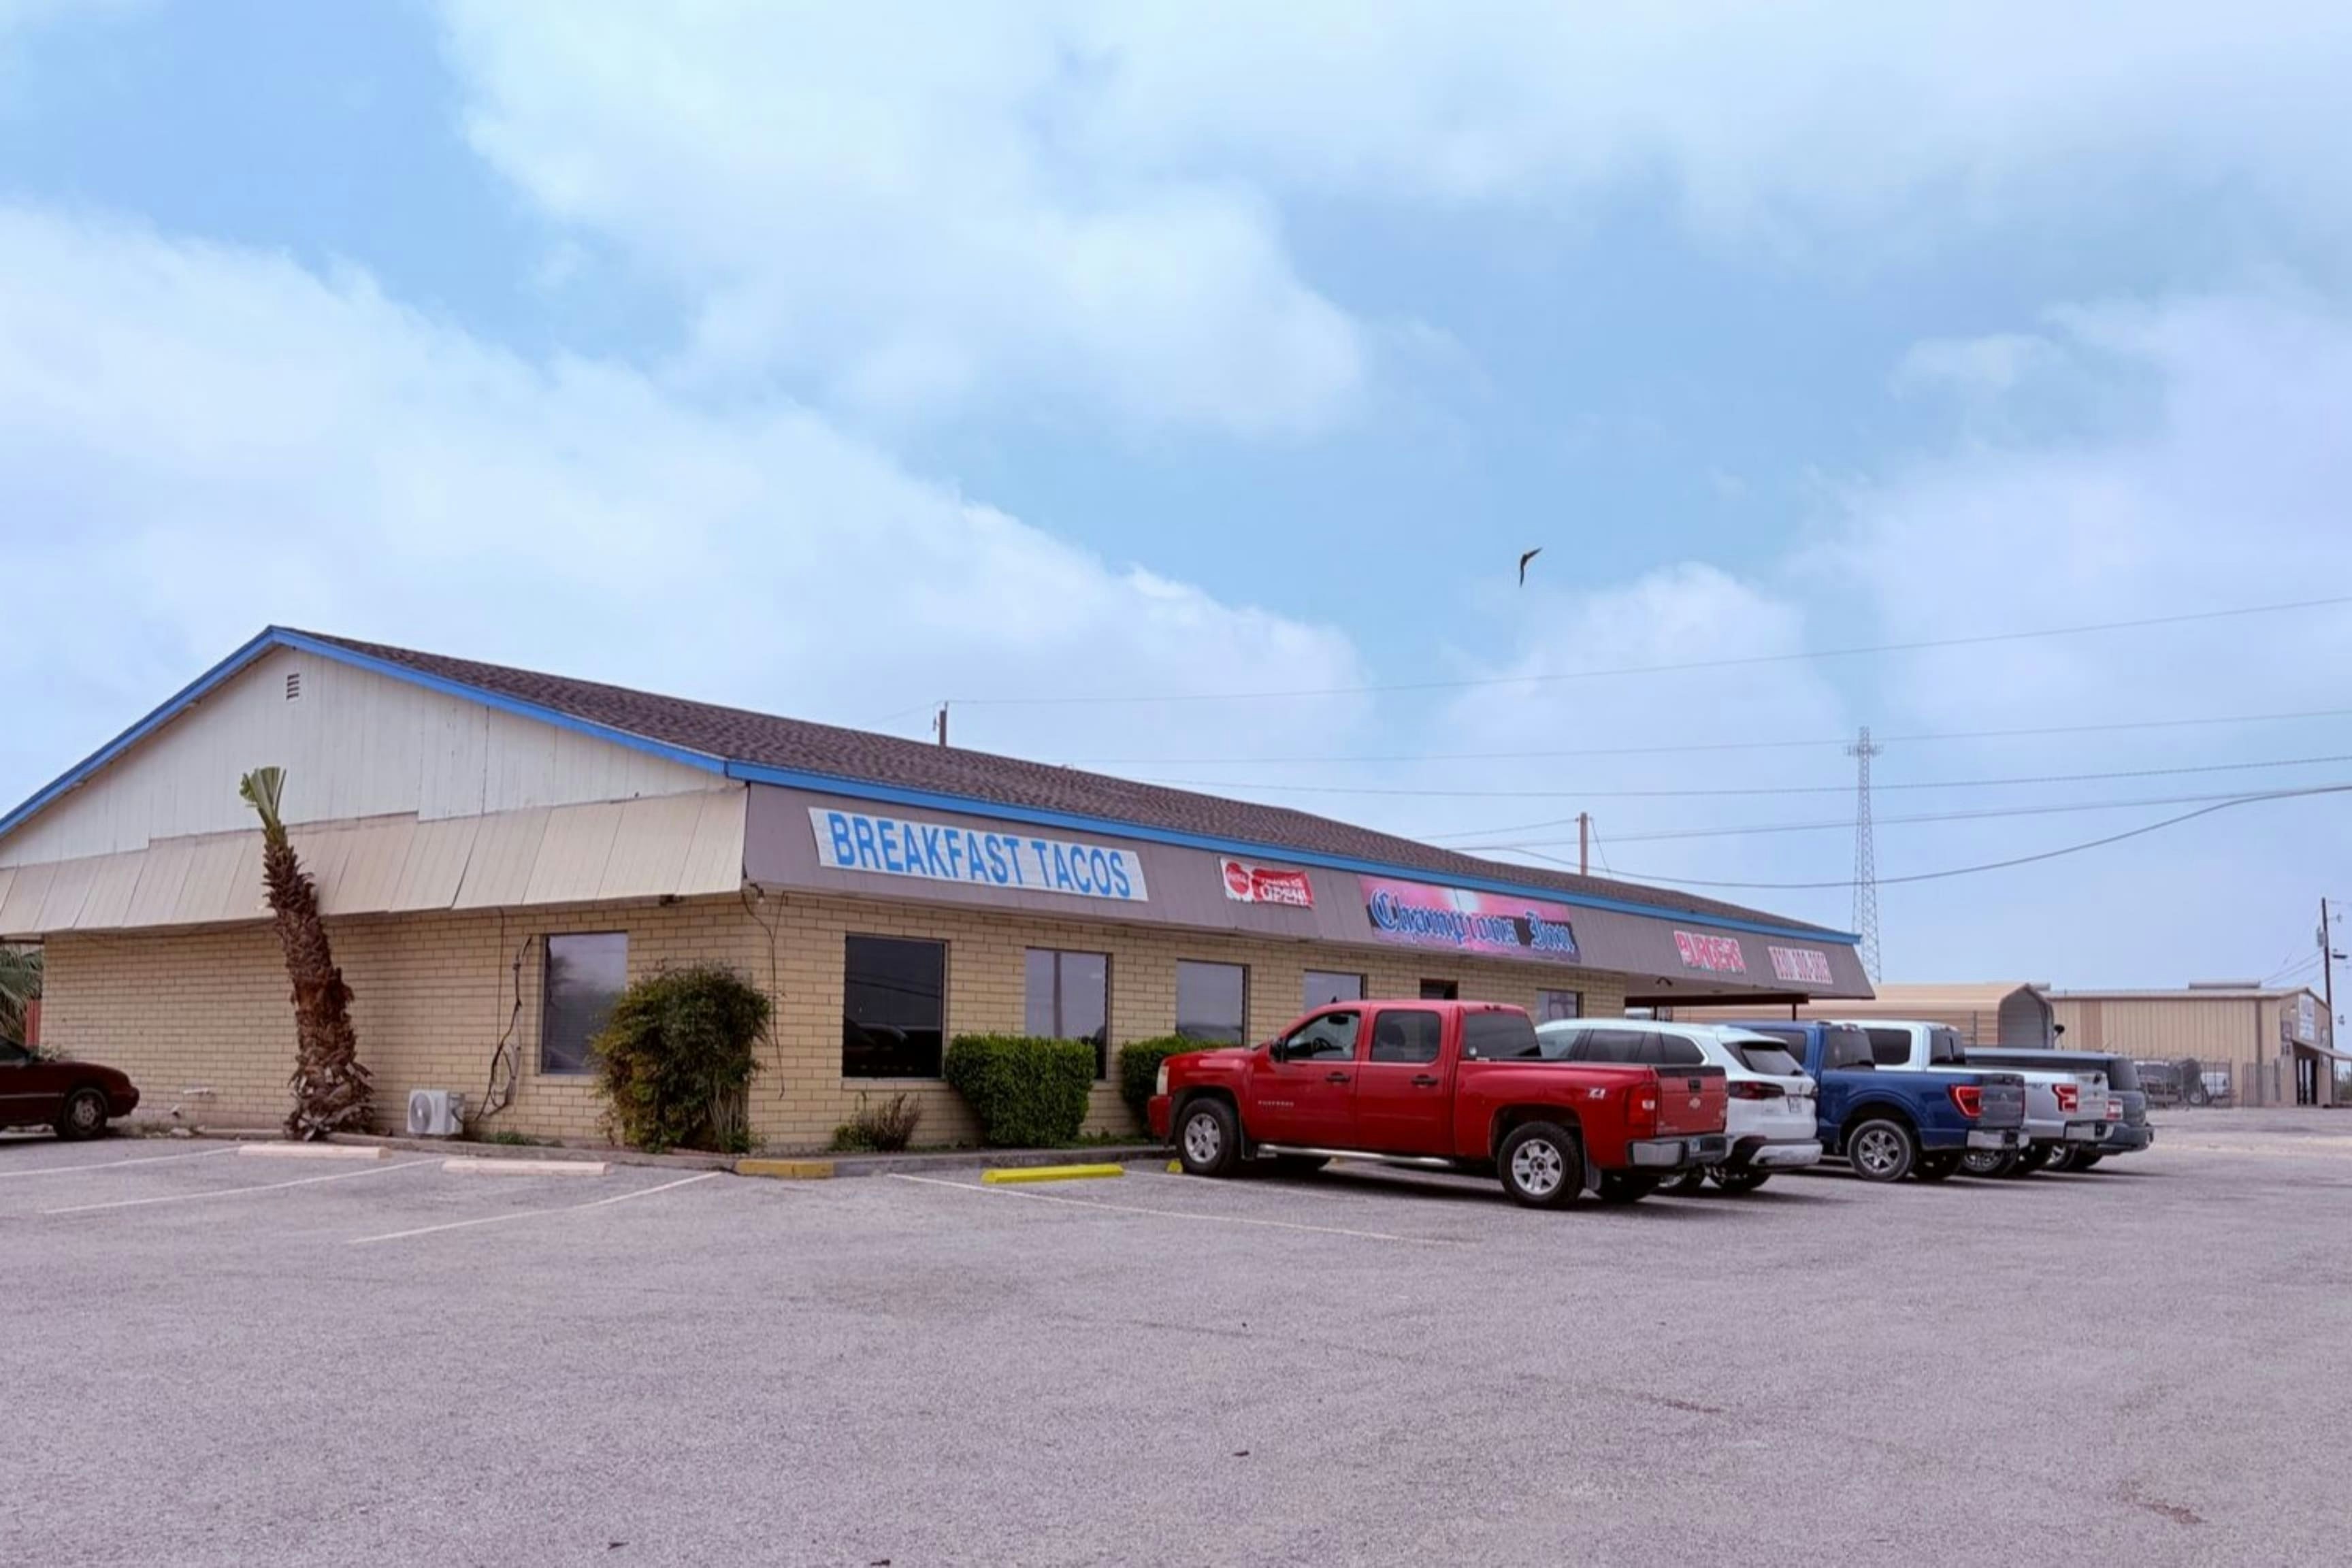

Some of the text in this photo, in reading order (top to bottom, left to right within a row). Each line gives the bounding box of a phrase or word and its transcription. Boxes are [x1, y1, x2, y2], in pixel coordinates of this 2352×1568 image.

[827, 812, 1131, 898] BREAKFAST TACOS
[1370, 887, 1520, 948] Champions
